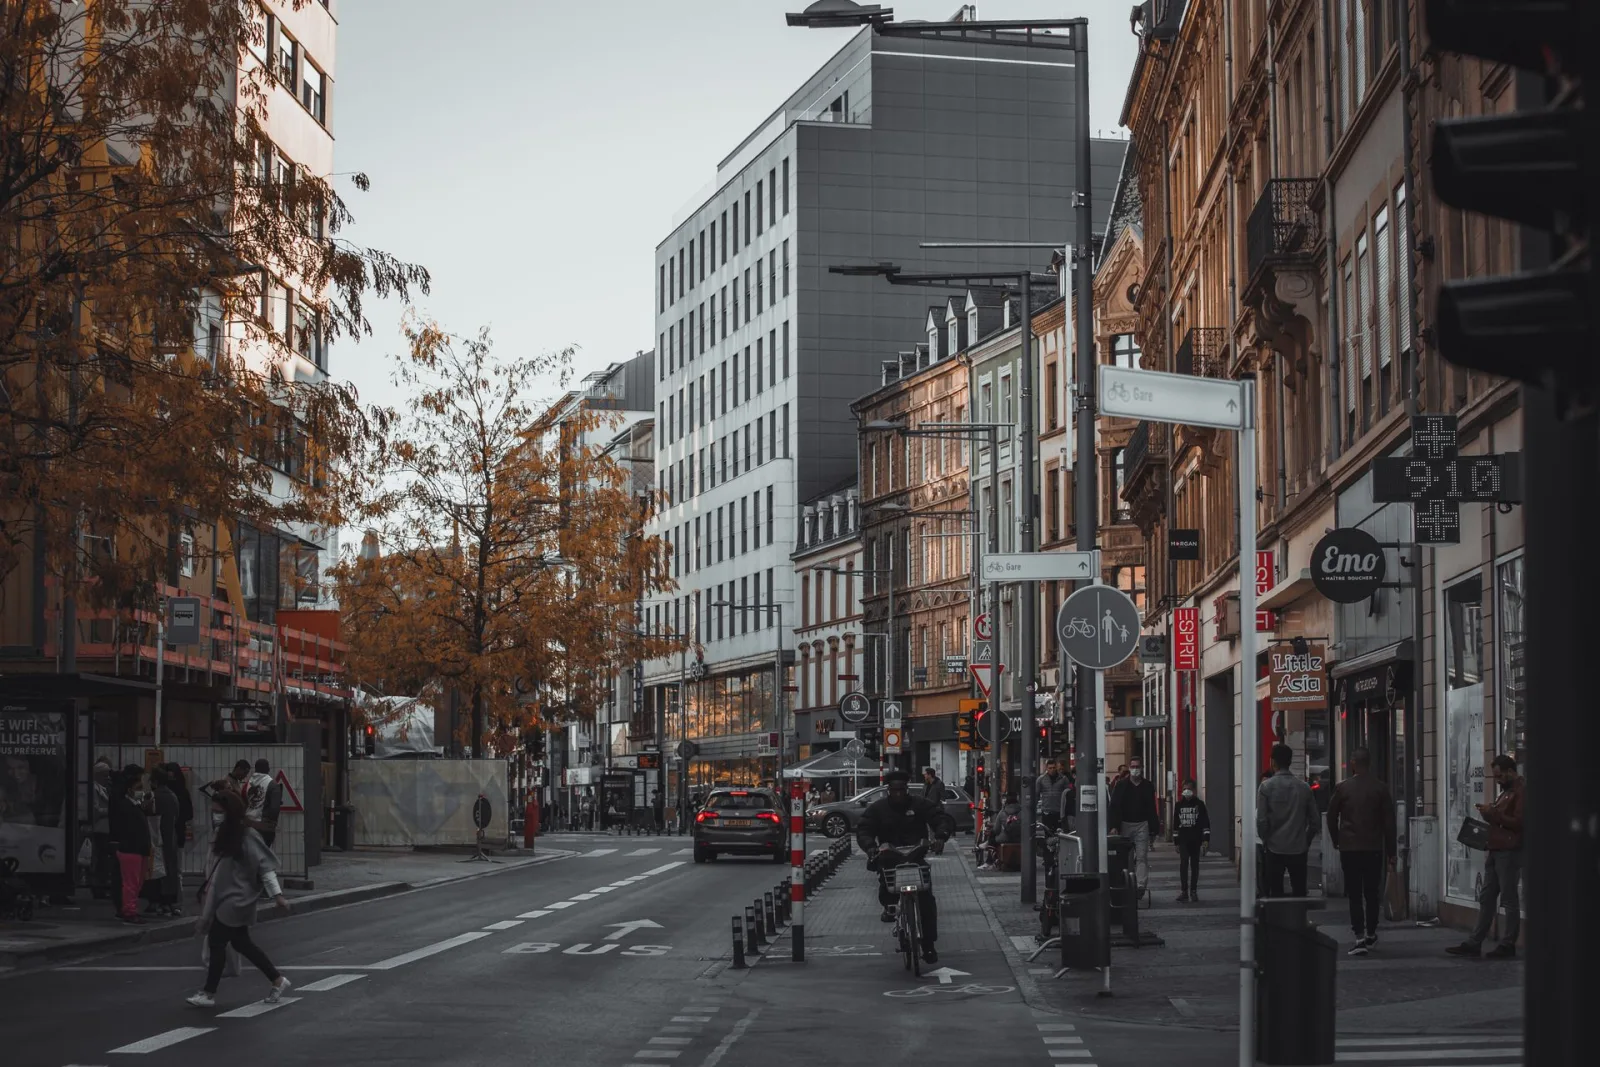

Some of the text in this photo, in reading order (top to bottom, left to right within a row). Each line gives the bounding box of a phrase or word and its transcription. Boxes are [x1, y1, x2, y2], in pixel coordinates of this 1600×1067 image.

[1133, 387, 1153, 401] Gare
[1321, 545, 1380, 573] Emo
[1006, 562, 1021, 571] Gare
[1178, 609, 1195, 669] ESPRIT
[1272, 653, 1323, 673] Little
[1277, 674, 1321, 694] Asia
[9, 719, 38, 731] WIFI
[14, 746, 57, 756] PRÉSERVE
[501, 942, 673, 956] BUS
